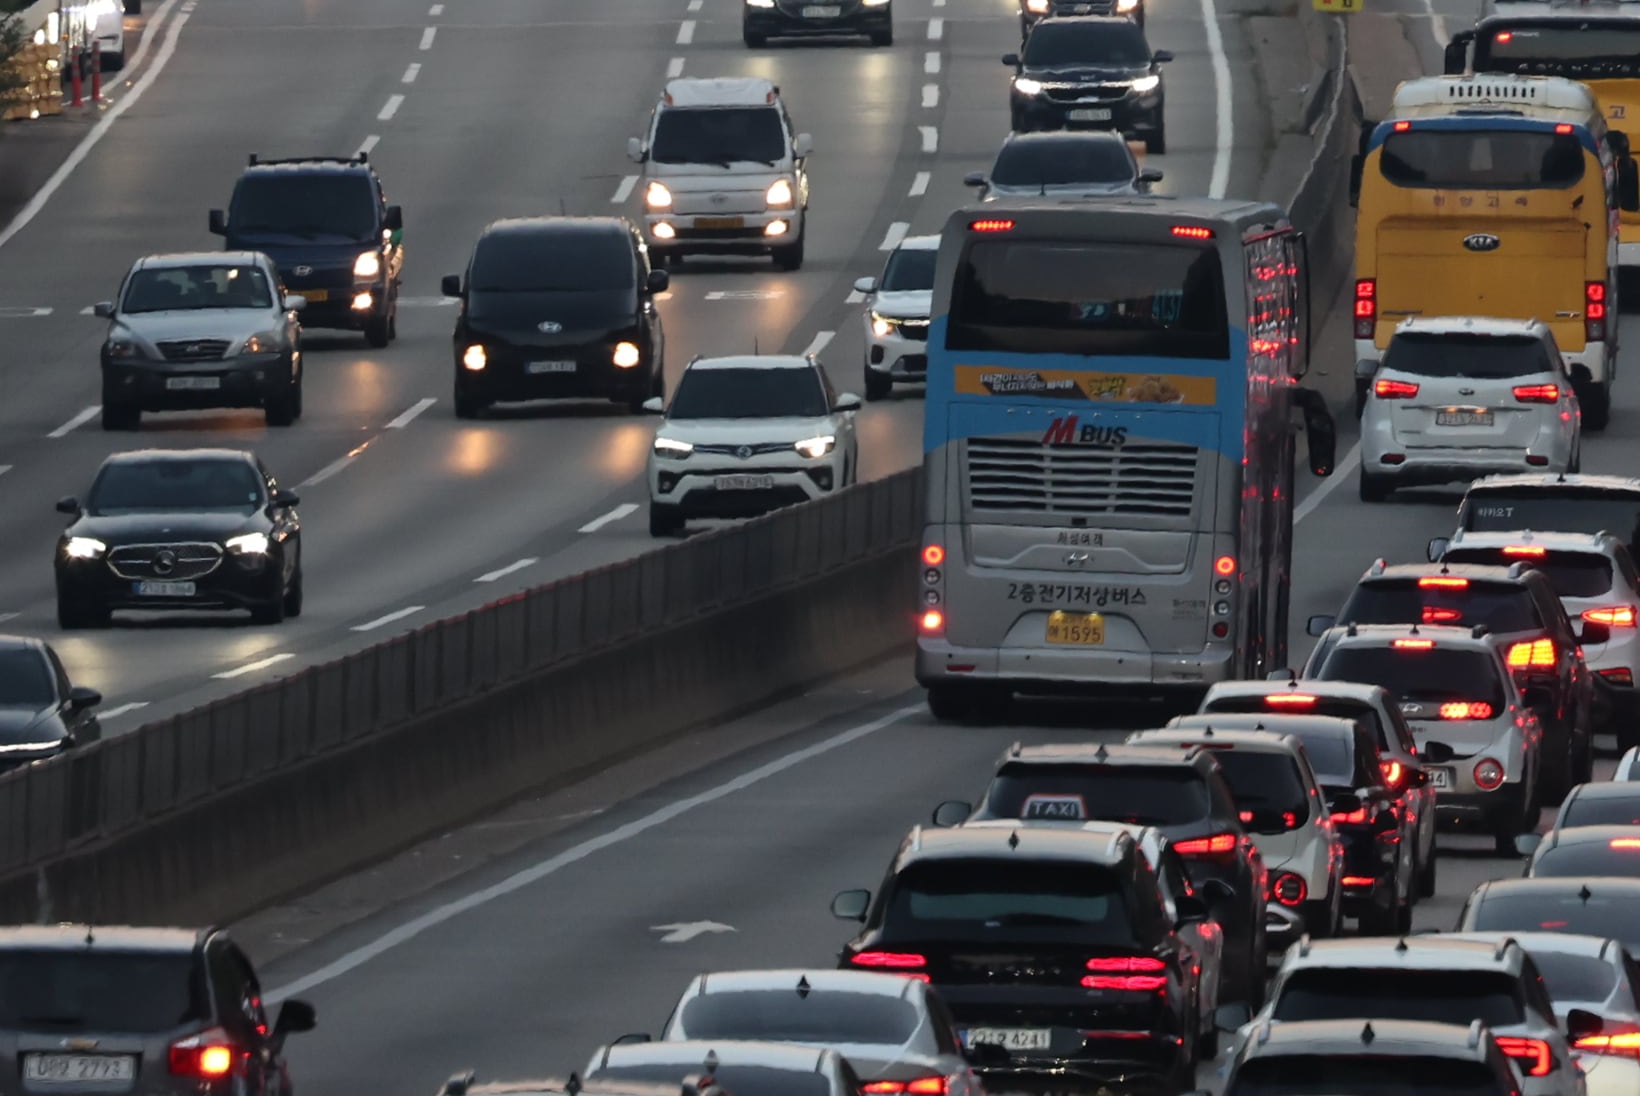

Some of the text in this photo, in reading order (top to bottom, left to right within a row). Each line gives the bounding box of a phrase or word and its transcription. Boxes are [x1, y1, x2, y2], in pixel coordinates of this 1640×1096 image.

[1469, 235, 1495, 249] KIA
[1041, 415, 1128, 445] M BUS
[1007, 583, 1147, 607] 2층전기저상버스
[1062, 625, 1101, 642] 1595
[1033, 802, 1076, 817] TAXI
